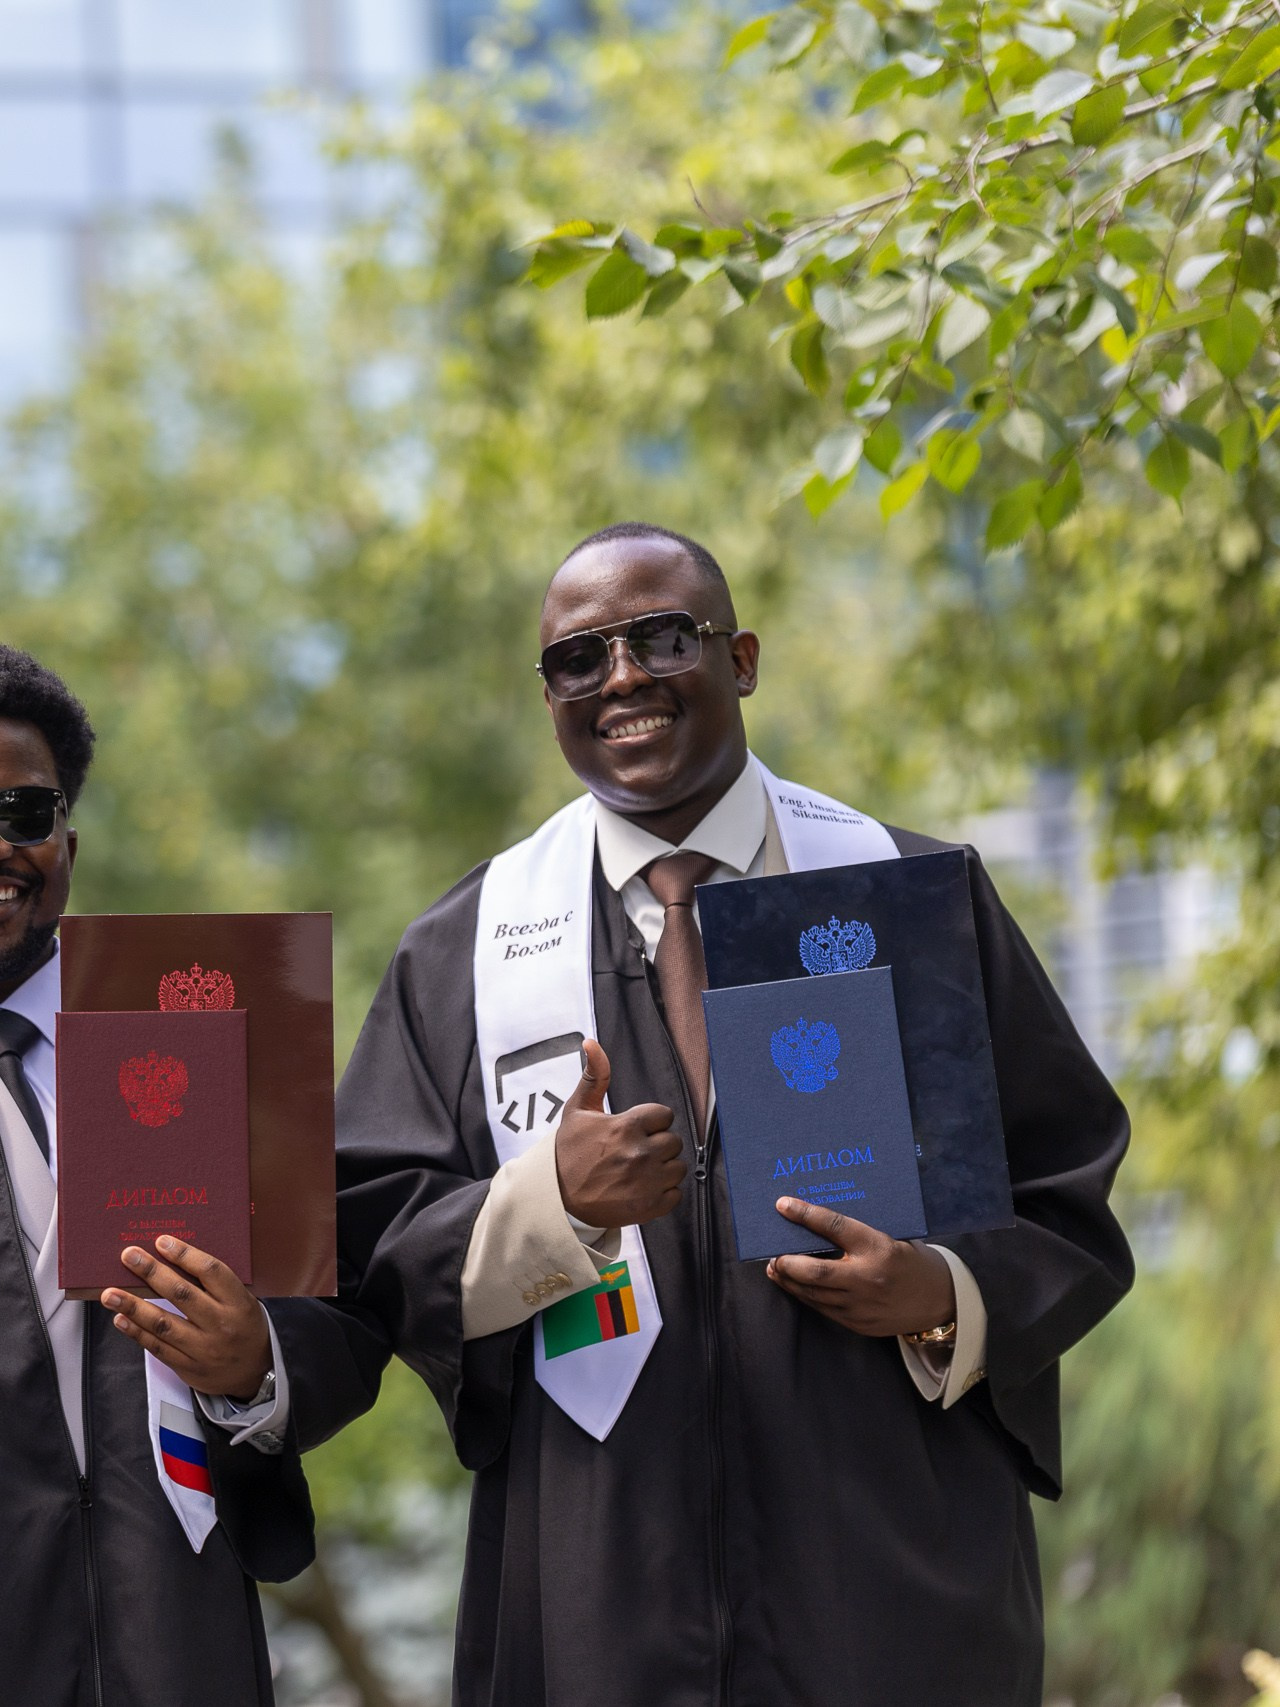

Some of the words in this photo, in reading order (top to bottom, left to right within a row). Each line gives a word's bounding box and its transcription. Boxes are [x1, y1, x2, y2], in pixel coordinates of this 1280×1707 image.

[778, 795, 807, 808] Eng.
[493, 917, 560, 940] Всегда
[503, 935, 562, 961] Богом
[772, 1145, 875, 1180] ДИПЛОМ
[106, 1187, 209, 1210] ДИПЛОМ
[797, 1187, 807, 1196] О
[808, 1180, 855, 1195] ВЫСШЕМ
[803, 1190, 866, 1205] РАЗОВАНИИ
